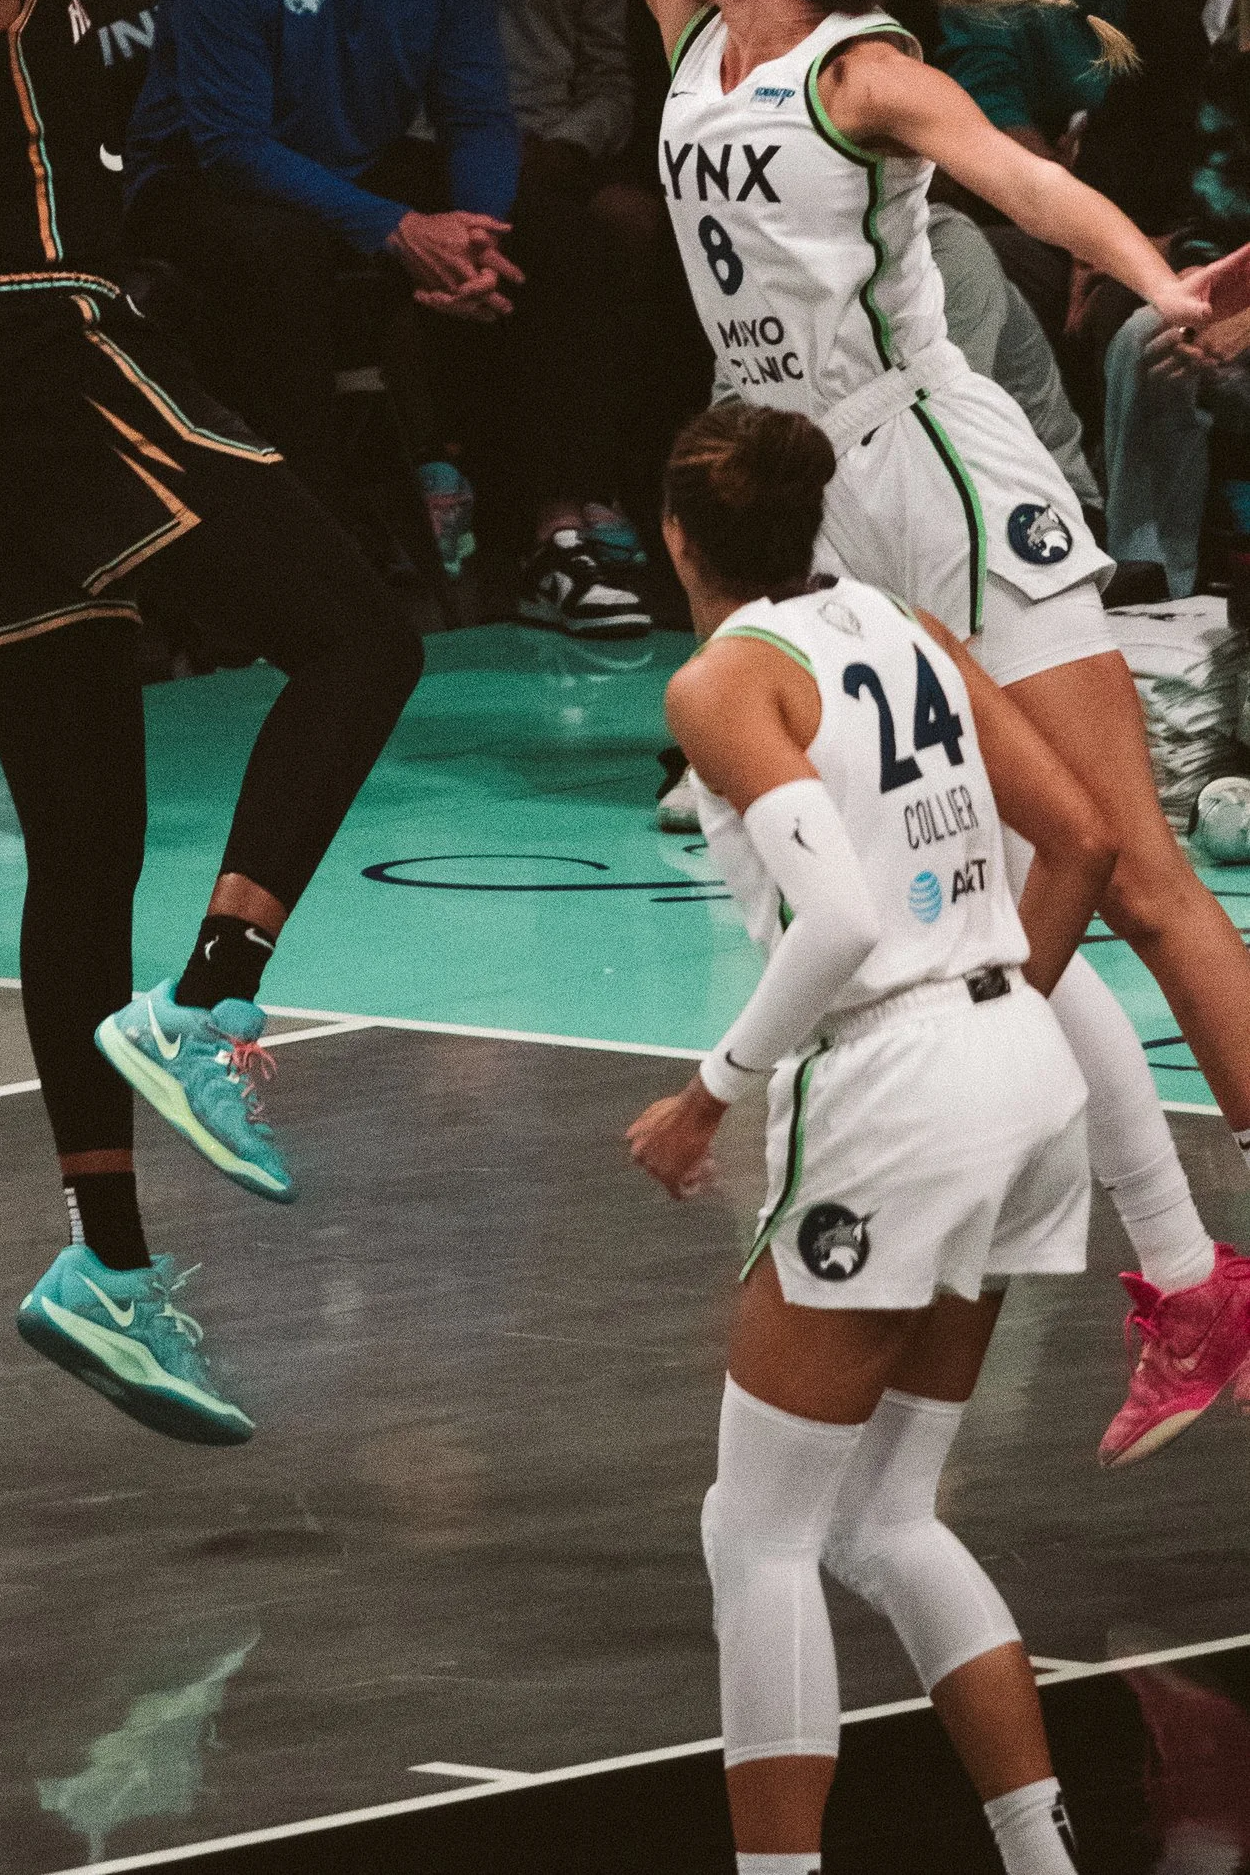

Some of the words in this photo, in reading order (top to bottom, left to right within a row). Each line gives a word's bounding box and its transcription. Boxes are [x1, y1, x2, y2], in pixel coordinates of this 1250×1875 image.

[660, 139, 782, 204] YNX
[698, 215, 744, 296] 8
[842, 641, 964, 795] 24
[903, 784, 979, 850] COLLIER
